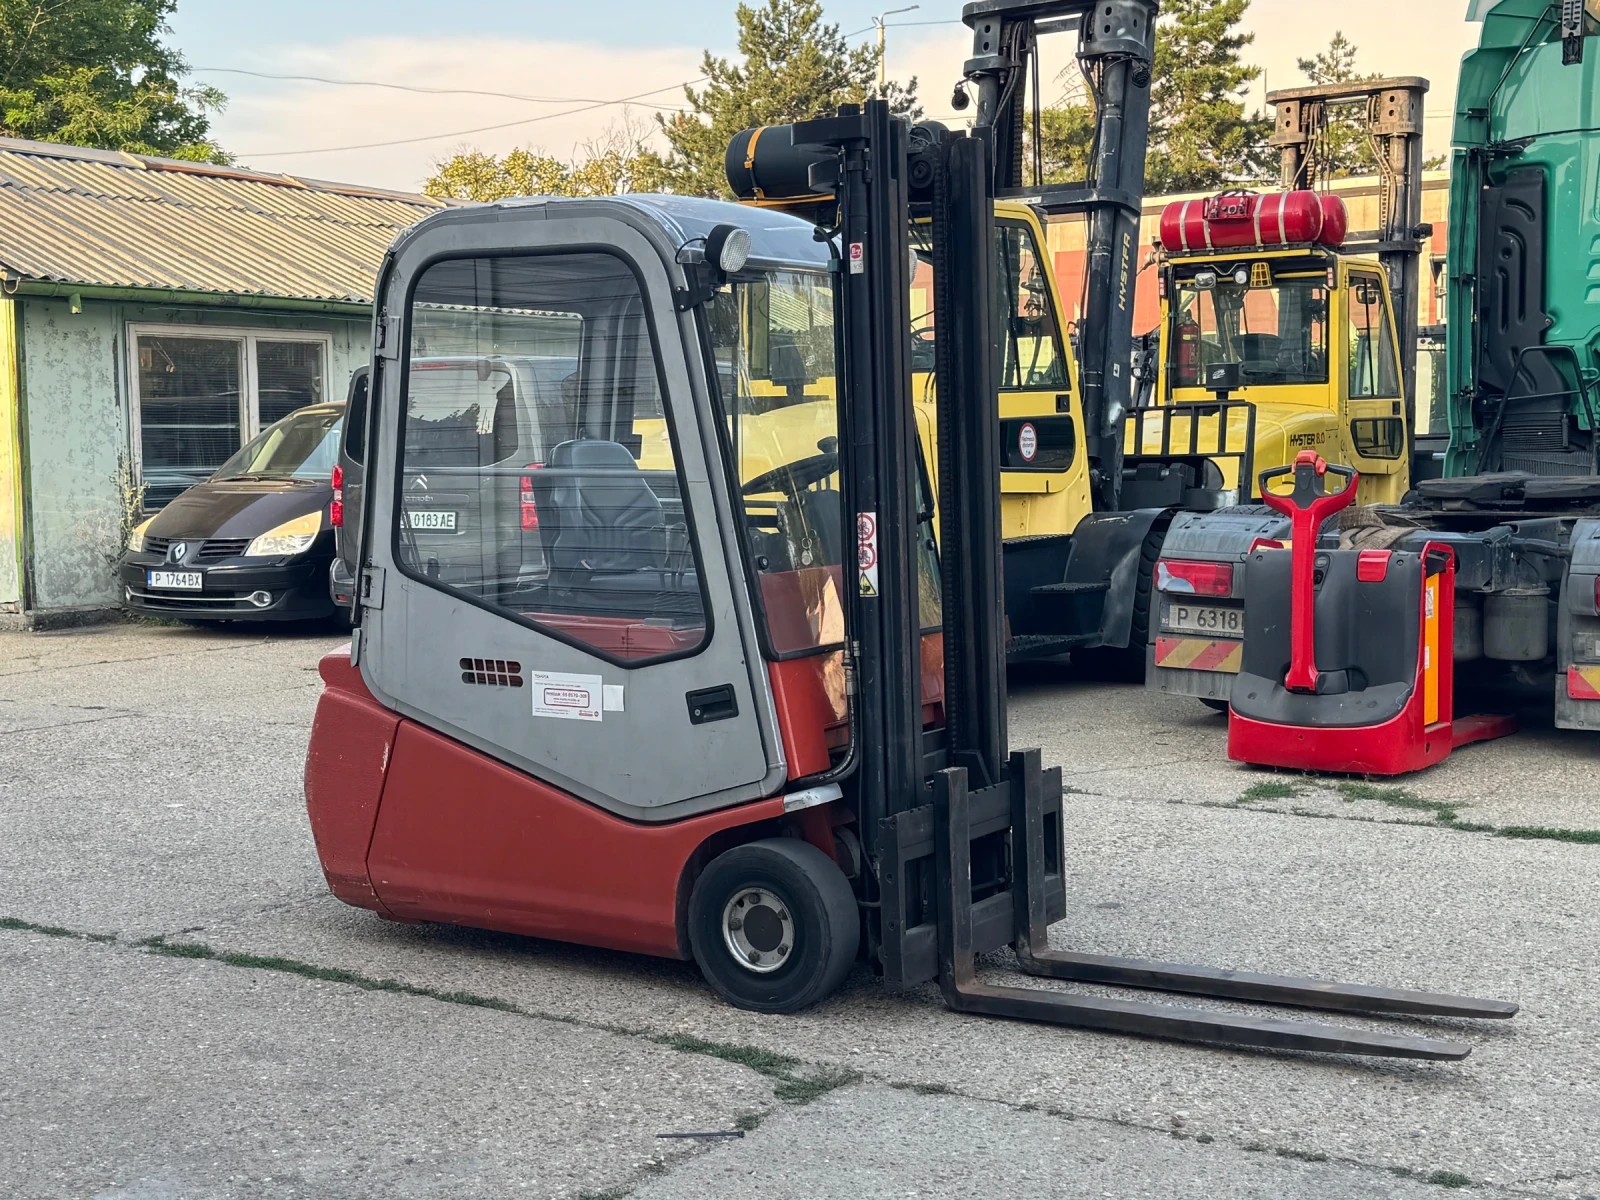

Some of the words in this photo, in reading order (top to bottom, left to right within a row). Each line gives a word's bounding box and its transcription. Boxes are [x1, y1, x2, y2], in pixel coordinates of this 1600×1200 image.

[1289, 434, 1315, 446] HYSTER
[414, 513, 438, 527] 0183
[440, 513, 454, 527] AE
[155, 573, 161, 585] P
[1177, 608, 1188, 626] P
[1197, 609, 1238, 630] 6318
